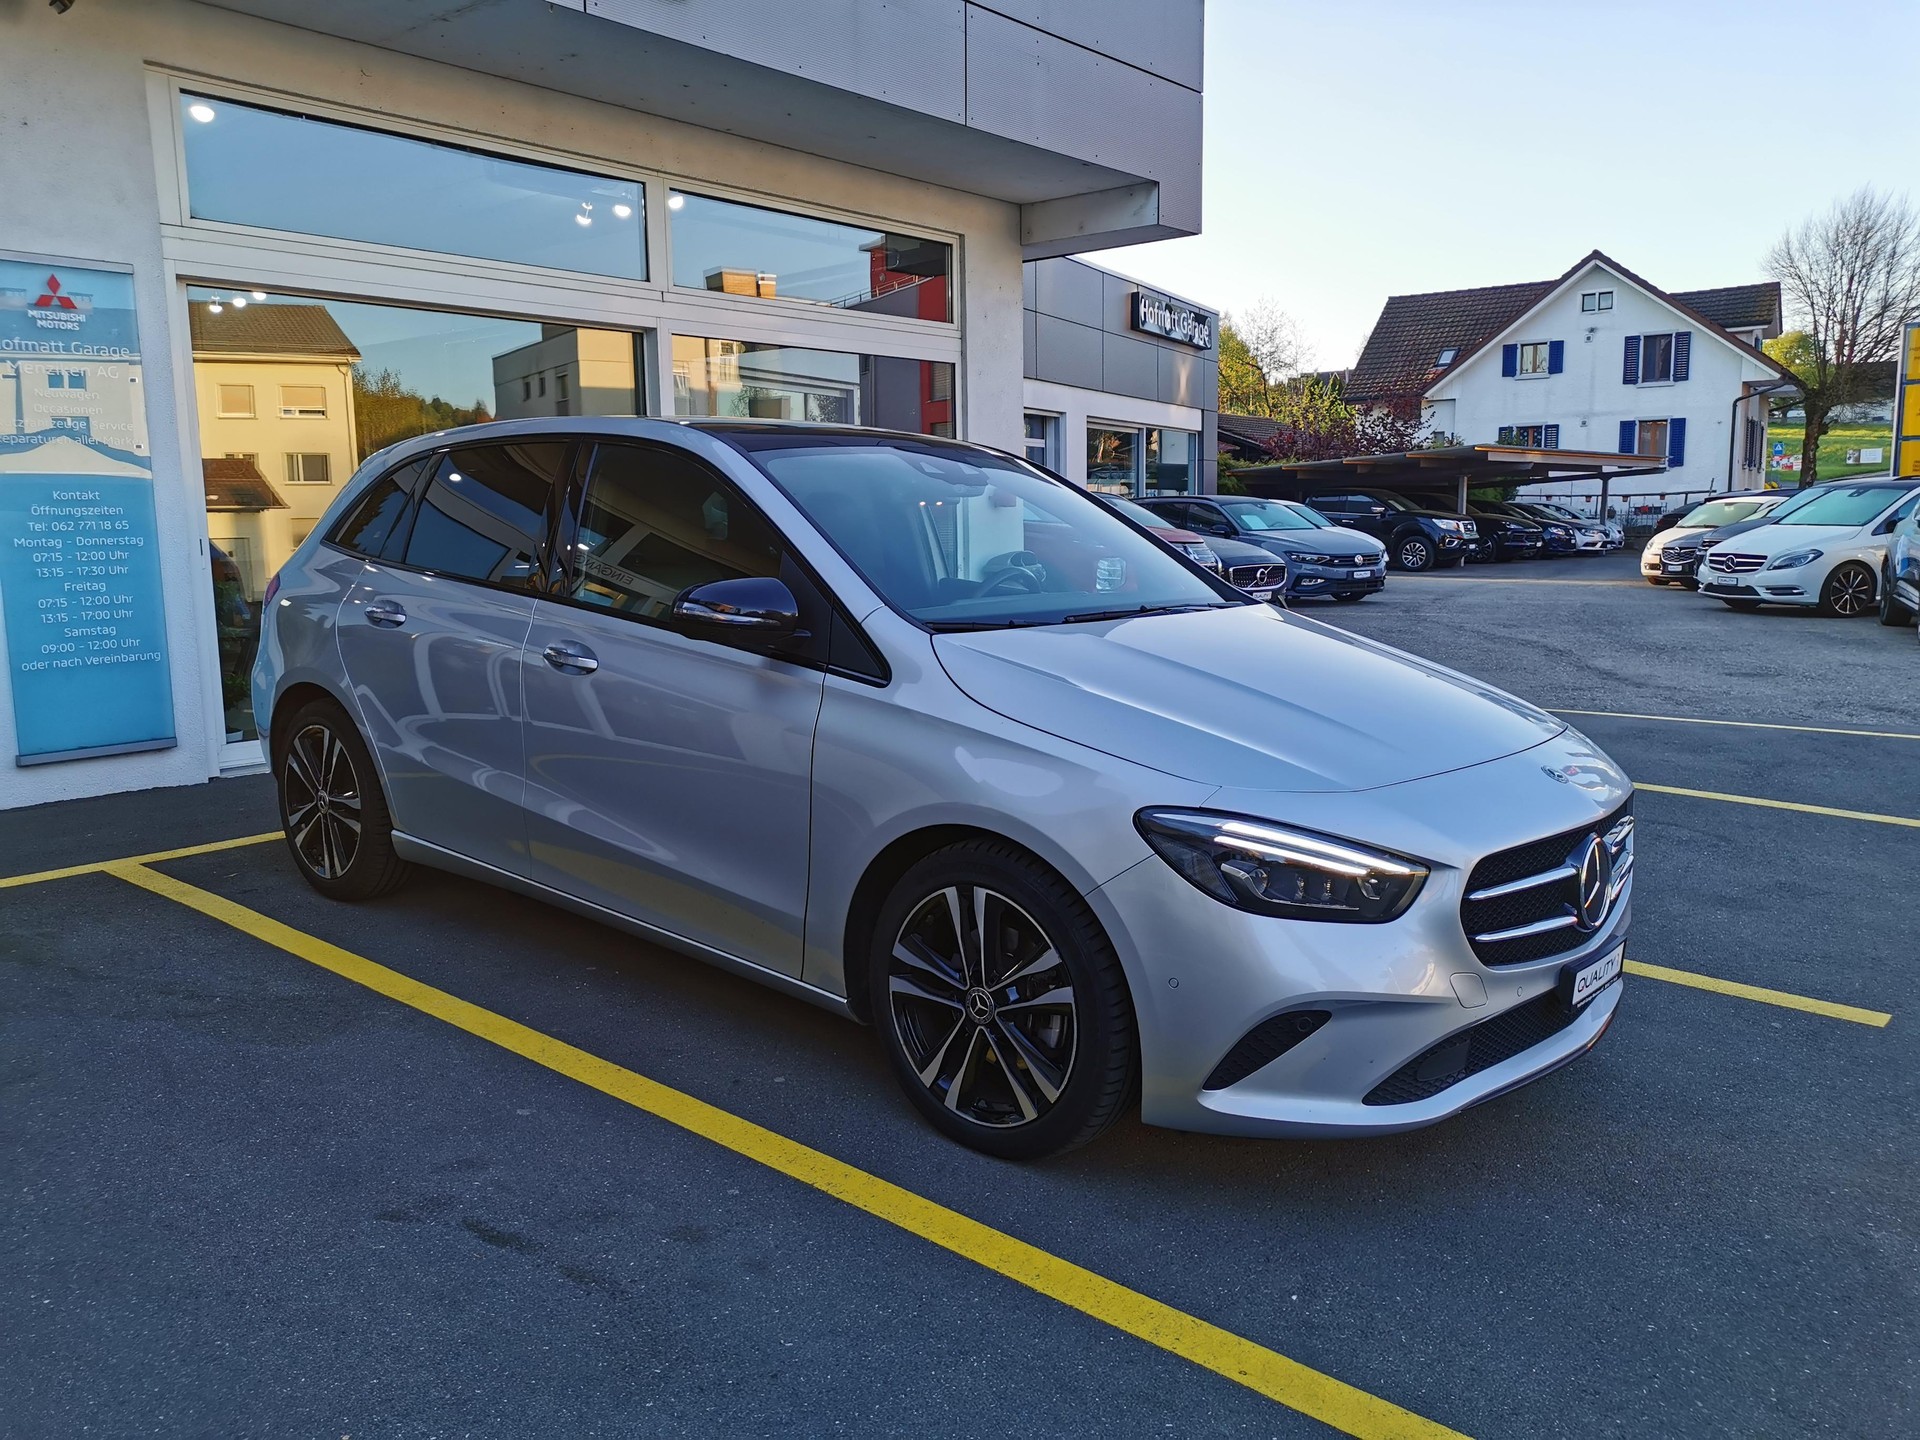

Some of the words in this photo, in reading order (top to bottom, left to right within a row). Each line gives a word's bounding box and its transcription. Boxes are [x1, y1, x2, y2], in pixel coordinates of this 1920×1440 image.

[27, 309, 86, 322] MITSUBISHI
[36, 319, 80, 331] MOTORS
[0, 337, 65, 354] ofmatt
[71, 342, 130, 360] Garage
[97, 365, 119, 379] AG
[33, 388, 100, 401] Neuwagen
[33, 404, 103, 415] Occasionen
[53, 490, 100, 500] Kontakt
[31, 503, 124, 517] Öffnungszeiten
[28, 521, 48, 531] Tel:
[51, 521, 75, 531] 062
[78, 521, 97, 530] 771
[99, 520, 111, 530] 18
[115, 520, 130, 530] 65
[14, 537, 63, 548] Montag
[76, 536, 144, 547] Donnerstag
[33, 552, 63, 562] 07:15
[75, 551, 106, 561] 12:00
[109, 550, 130, 560] Uhr
[36, 568, 64, 578] 13:15
[76, 566, 106, 576] 17:30
[109, 565, 129, 575] Uhr
[64, 581, 106, 592] Freitag
[38, 598, 68, 609] 07:15
[80, 596, 110, 606] 12:00
[113, 595, 134, 604] Uhr
[41, 613, 69, 624] 13:15
[81, 611, 110, 621] 17:00
[113, 609, 134, 619] Uhr
[64, 625, 117, 638] Samstag
[41, 642, 75, 654] 09:00
[88, 640, 118, 651] 12:00
[120, 638, 141, 648] Uhr
[21, 660, 50, 671] oder
[53, 657, 82, 669] nach
[85, 651, 161, 666] Vereinbarung
